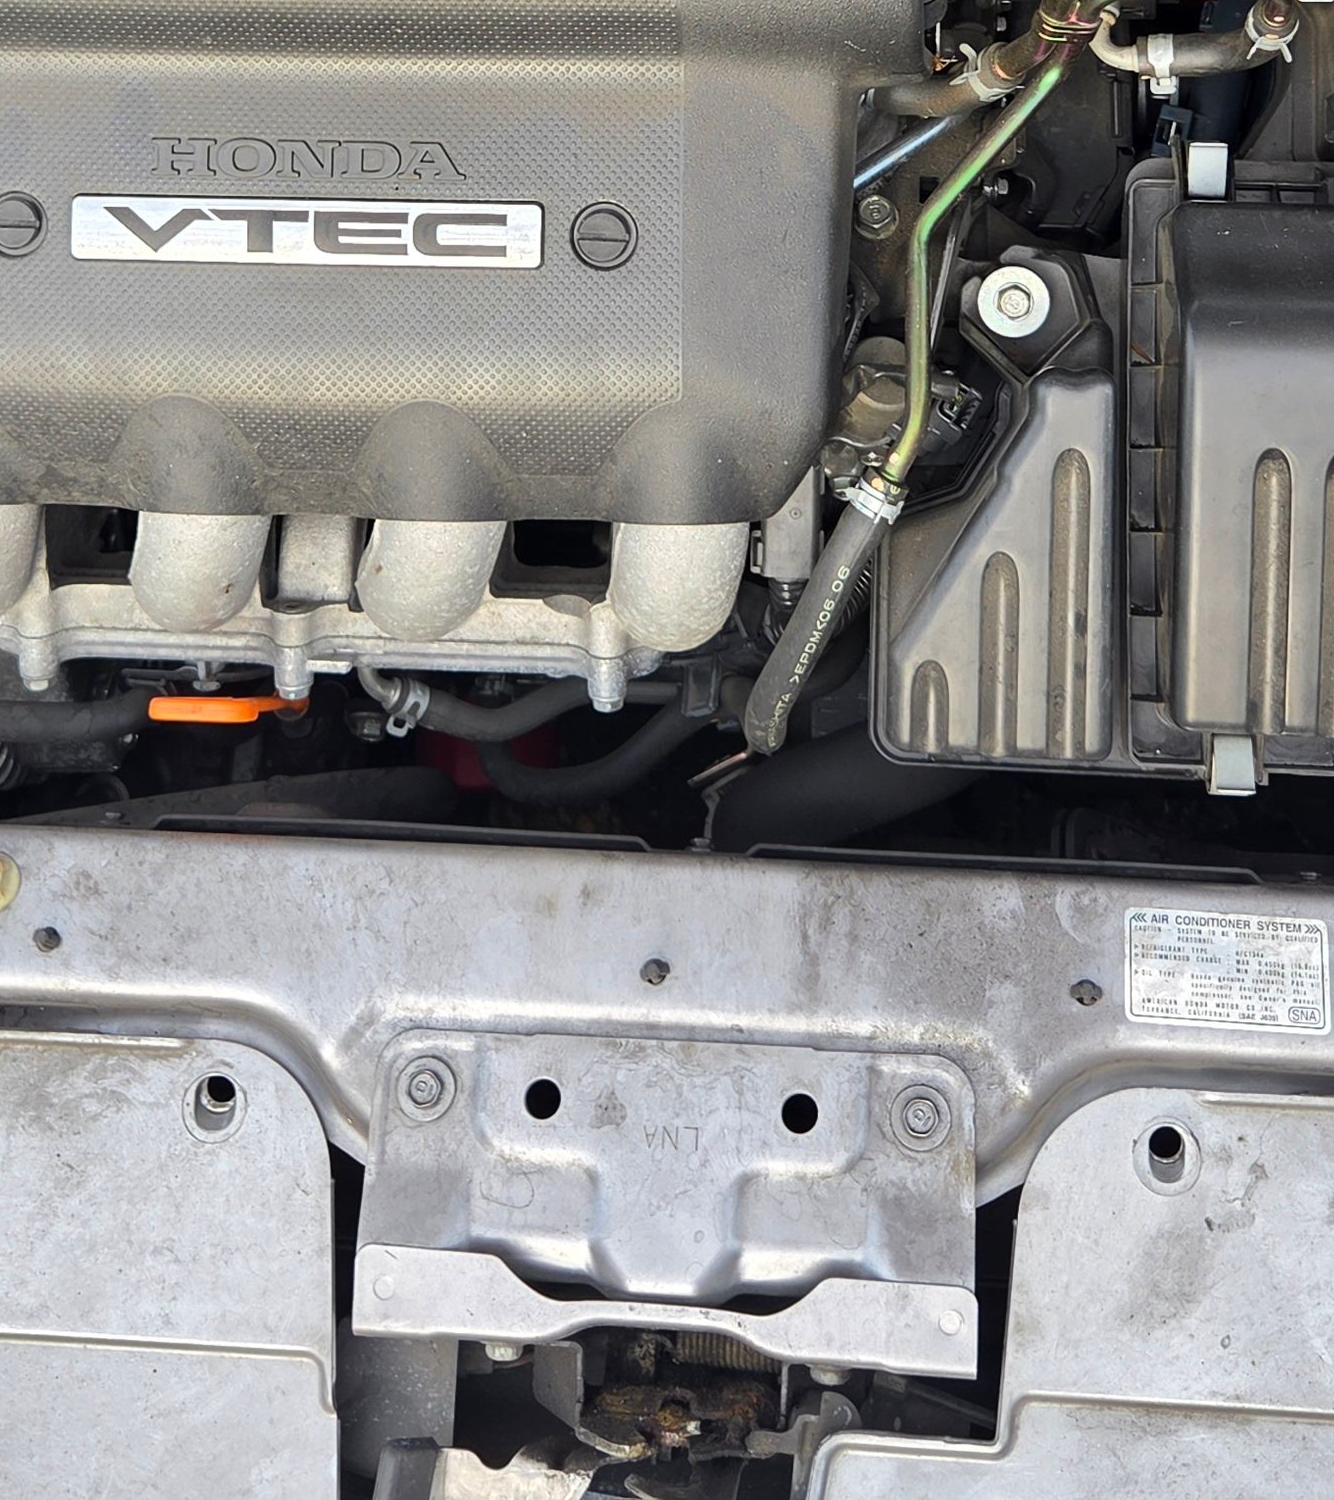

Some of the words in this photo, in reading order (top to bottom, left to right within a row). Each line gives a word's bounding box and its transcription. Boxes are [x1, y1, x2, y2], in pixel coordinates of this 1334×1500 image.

[150, 136, 467, 182] HONDA
[102, 206, 509, 257] VTEC
[1150, 913, 1169, 925] AIR
[1175, 914, 1252, 930] CONDITIONER
[1257, 920, 1303, 934] SYSTEM
[1291, 1009, 1317, 1022] SNA
